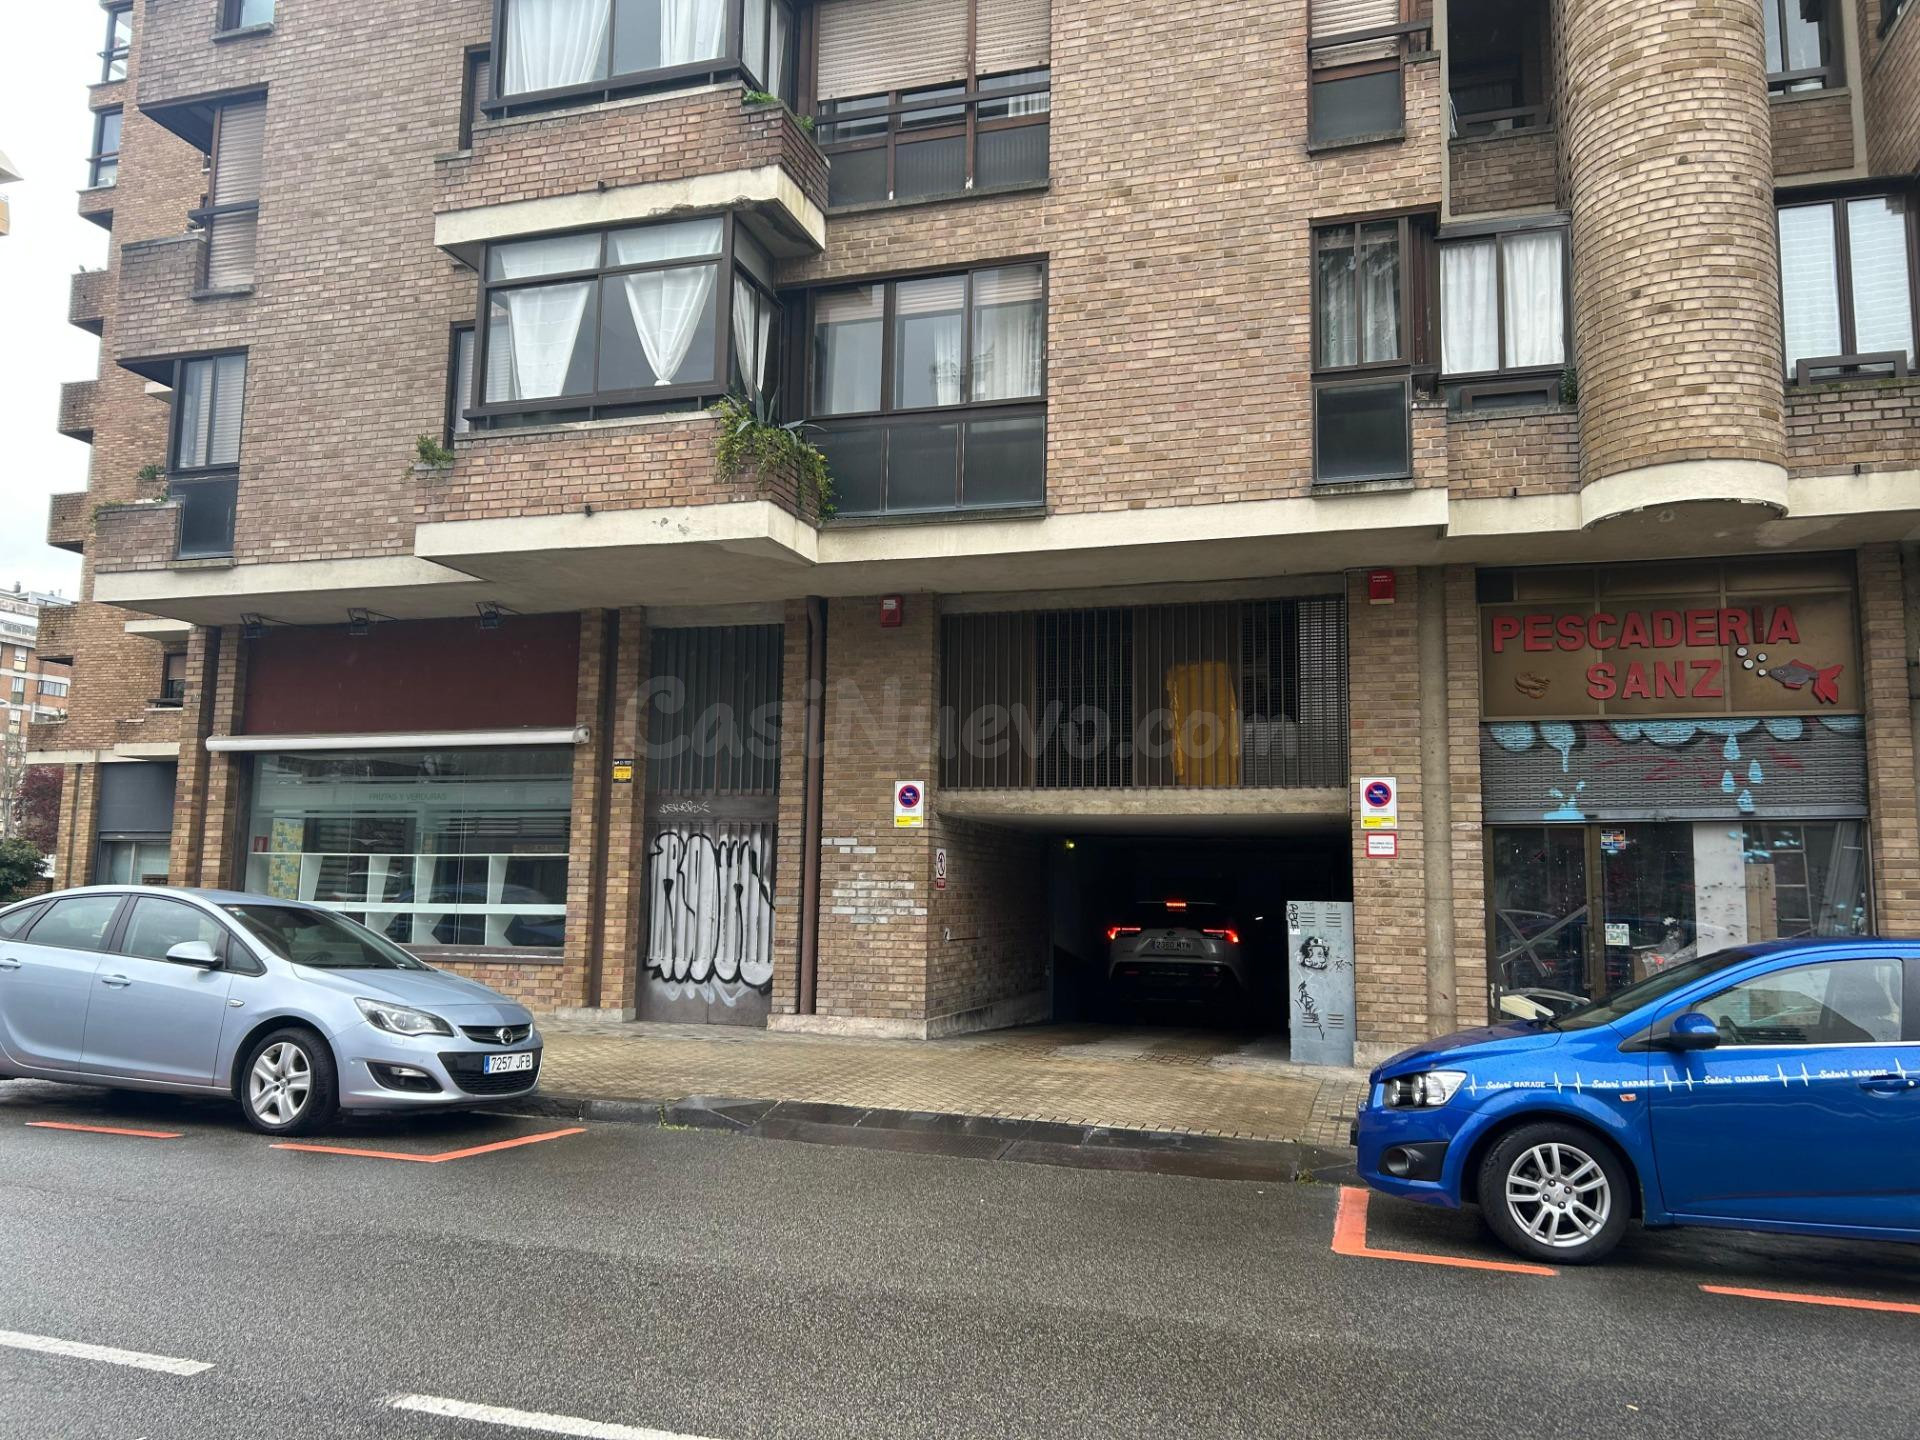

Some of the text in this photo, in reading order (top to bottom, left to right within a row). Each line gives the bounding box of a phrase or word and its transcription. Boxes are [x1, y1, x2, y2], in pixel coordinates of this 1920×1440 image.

[1492, 605, 1800, 654] PESCADERIA
[1586, 658, 1724, 700] SANZ
[405, 791, 448, 801] VERDURAS
[491, 1054, 531, 1071] 7257 JFB
[1851, 1069, 1888, 1078] GARAGE
[1621, 1079, 1656, 1088] GARAGE
[1734, 1075, 1770, 1084] GARAGE
[1513, 1081, 1547, 1089] GARAGE
